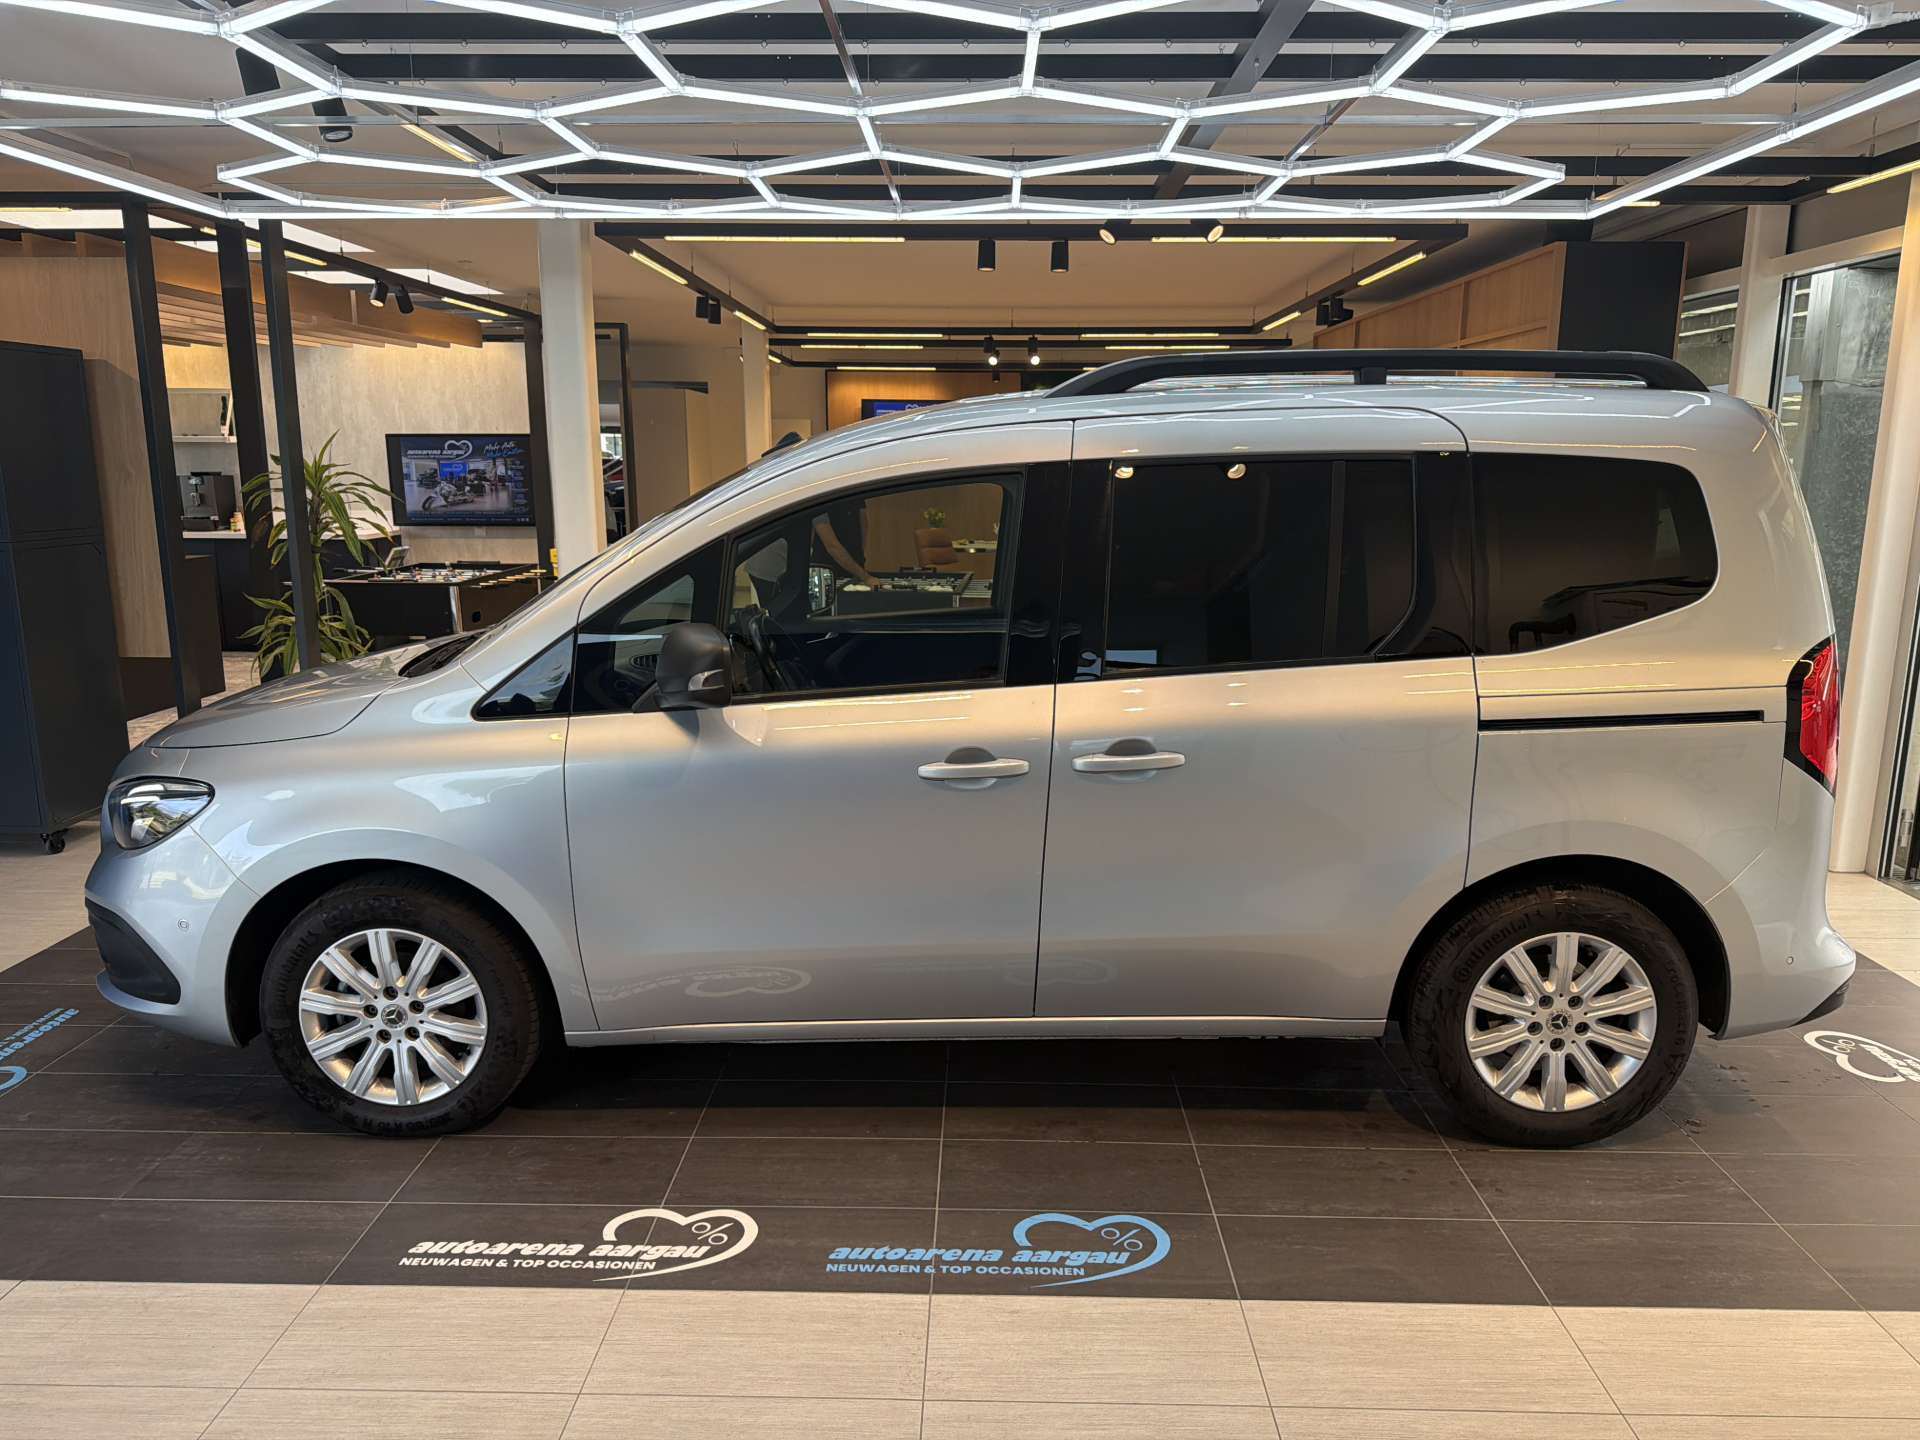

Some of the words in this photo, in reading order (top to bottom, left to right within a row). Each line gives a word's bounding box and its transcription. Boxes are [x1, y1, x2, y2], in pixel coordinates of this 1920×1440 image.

[407, 1239, 585, 1256] autoarena
[588, 1244, 712, 1260] aargau
[828, 1244, 1003, 1262] autoarena
[1011, 1249, 1130, 1266] aargau
[398, 1257, 495, 1267] NEUWAGEN
[495, 1258, 508, 1267] &
[512, 1259, 545, 1268] TOP
[546, 1259, 656, 1270] OCCASIONEN
[826, 1263, 920, 1273] NEUWAGEN
[923, 1264, 936, 1274] &
[940, 1265, 972, 1274] TOP
[975, 1266, 1085, 1276] OCCASIONEN
